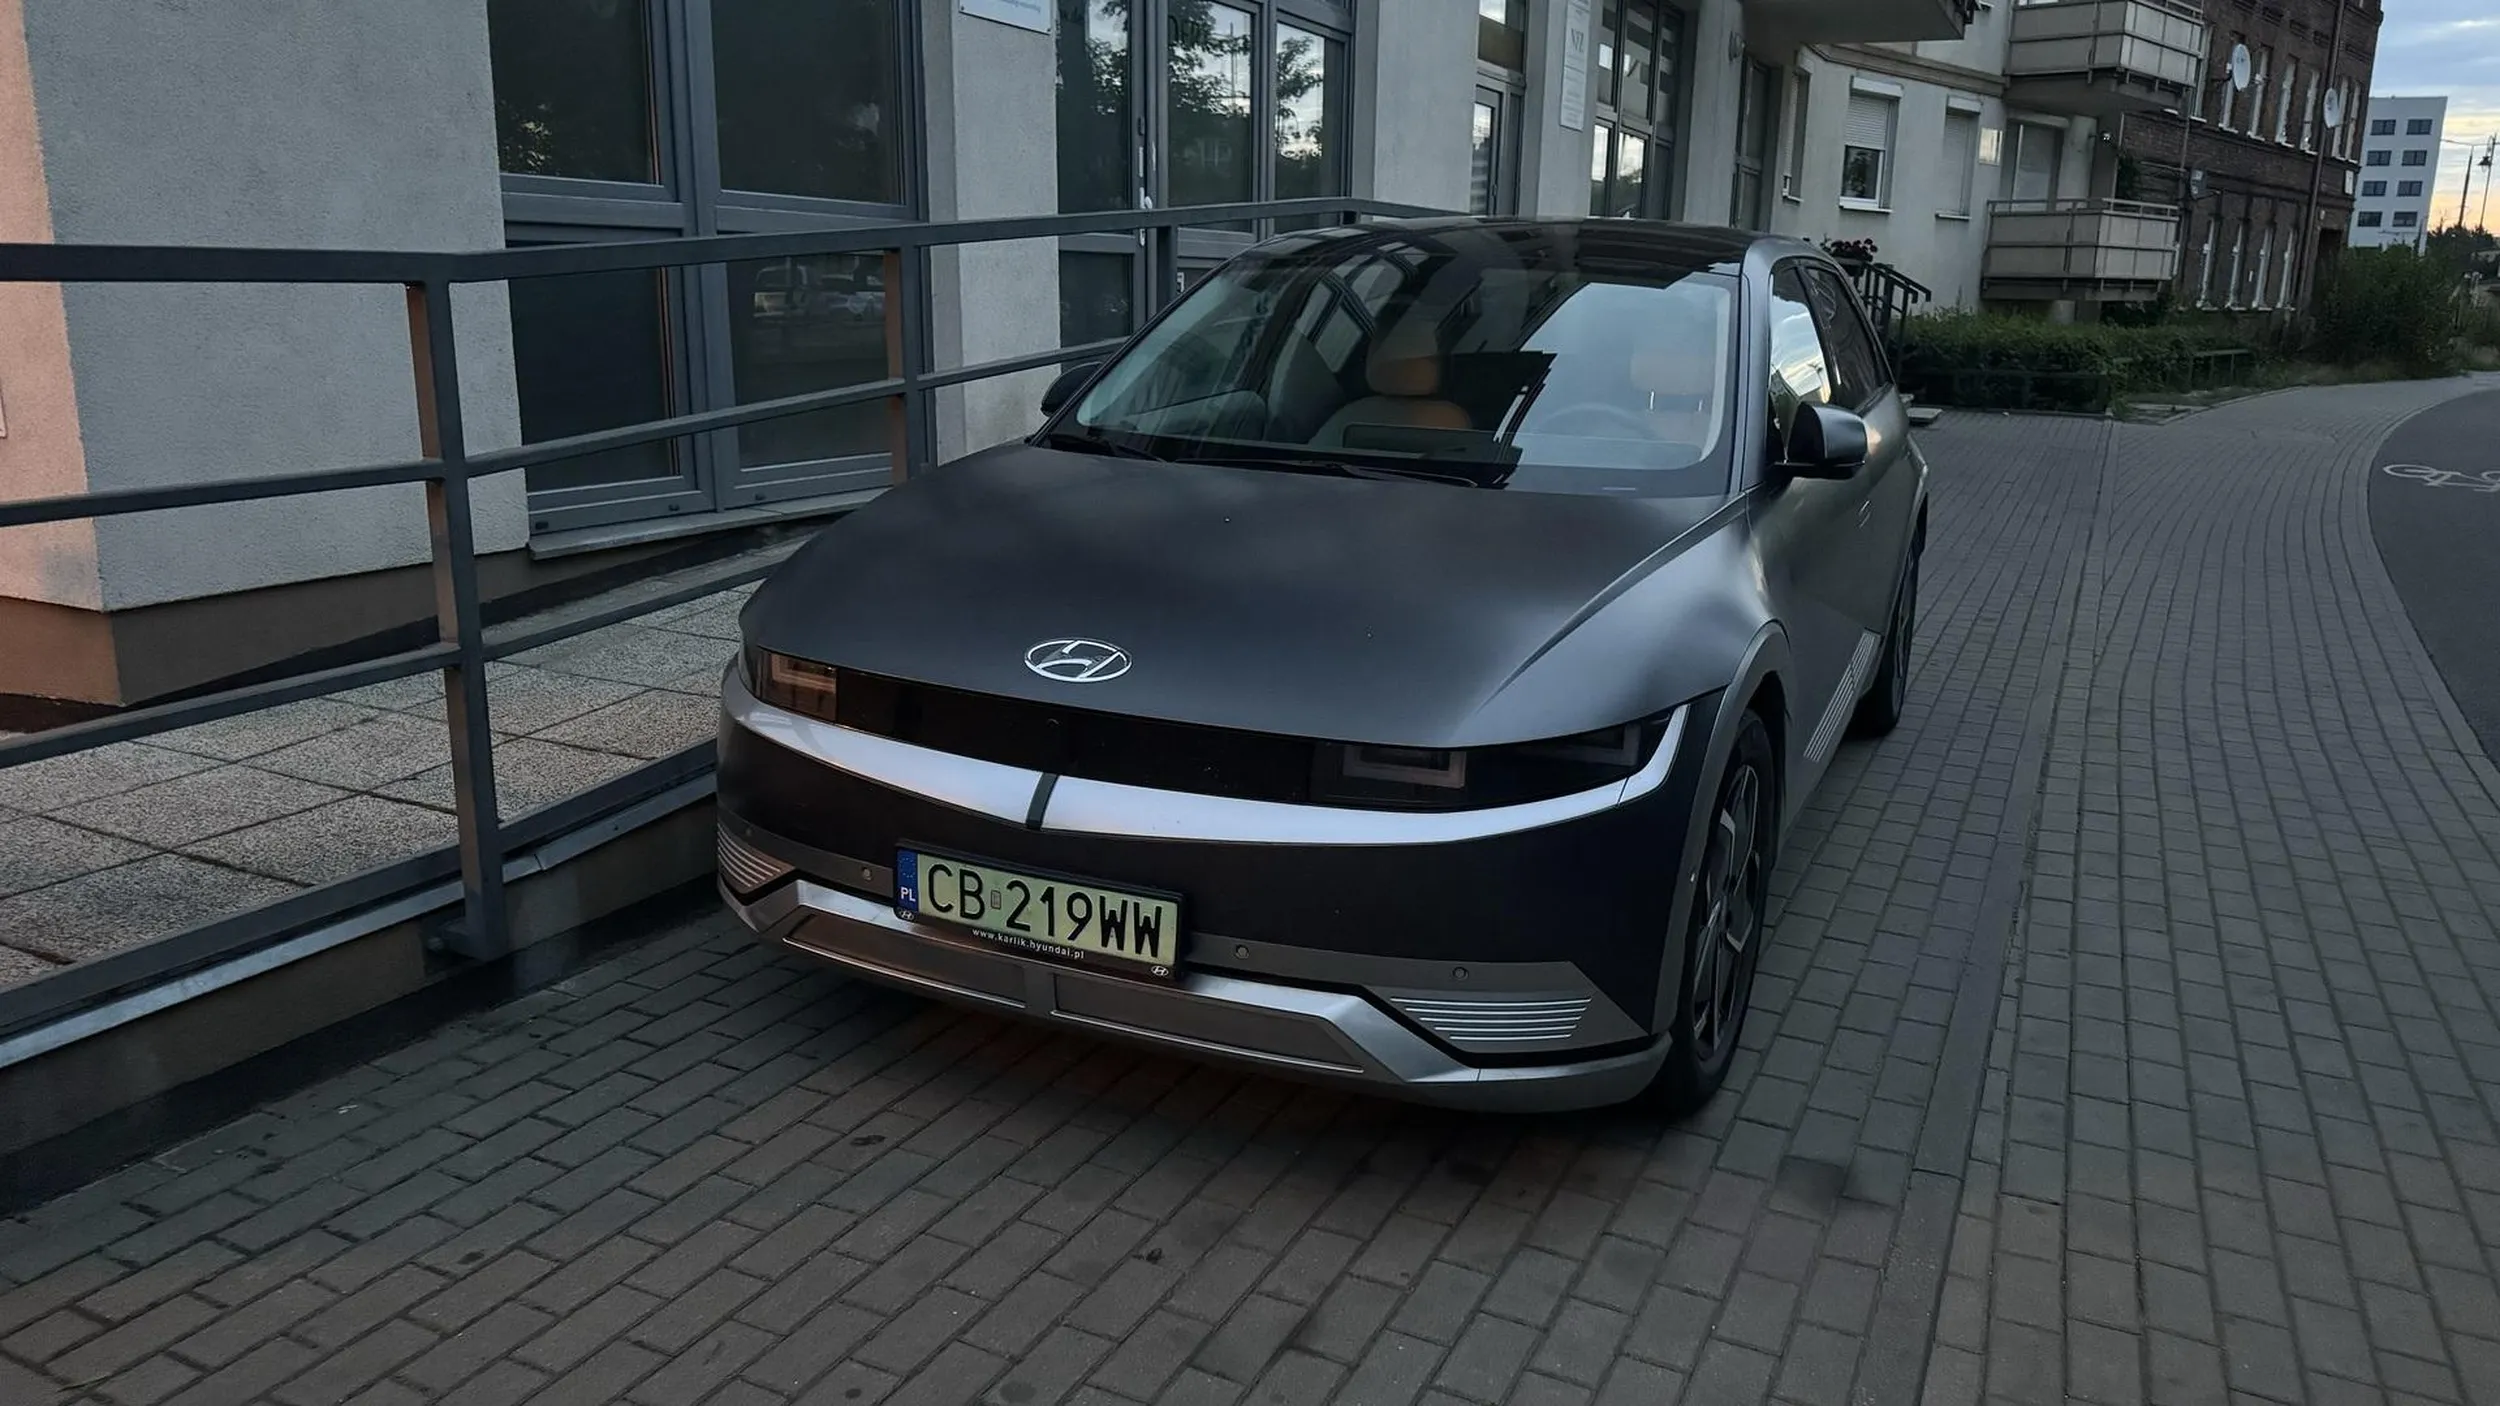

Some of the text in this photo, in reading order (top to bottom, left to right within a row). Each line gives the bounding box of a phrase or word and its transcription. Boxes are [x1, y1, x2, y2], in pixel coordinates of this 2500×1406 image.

[900, 887, 916, 902] PL
[928, 863, 1162, 958] CB 219WW
[972, 929, 1085, 959] www.karlik.hyundai.pl
